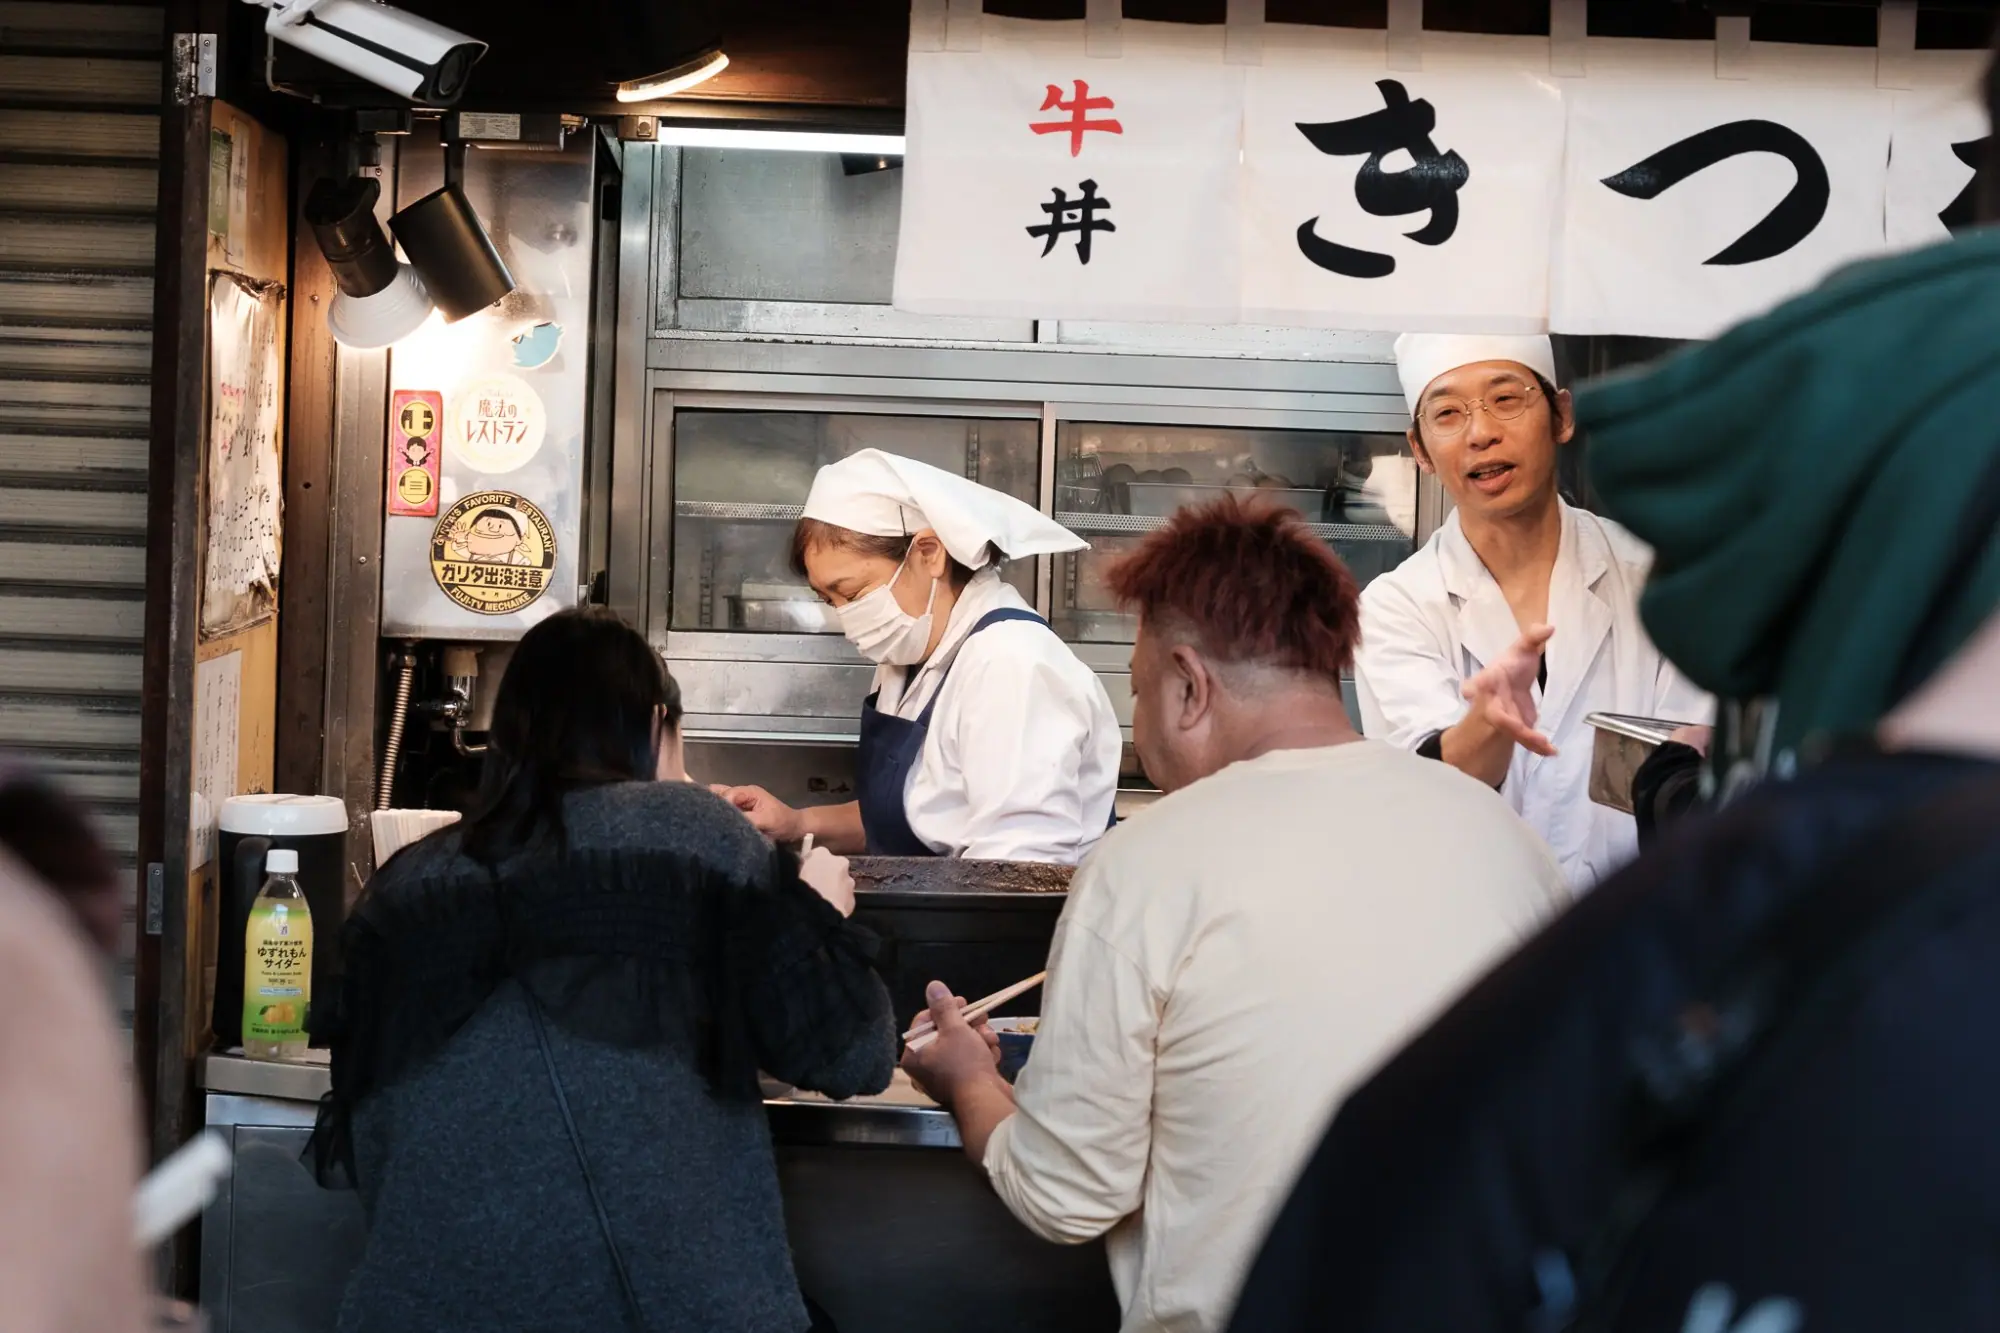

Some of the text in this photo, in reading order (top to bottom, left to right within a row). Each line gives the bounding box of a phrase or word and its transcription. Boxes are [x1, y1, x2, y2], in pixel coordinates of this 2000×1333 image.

[1026, 79, 1123, 265] 牛丼
[1296, 80, 1985, 278] きつ
[479, 398, 518, 418] 魔法の
[467, 420, 528, 445] レストラン
[464, 495, 512, 510] FAVORITE
[516, 500, 553, 553] ESTAURANT
[442, 563, 543, 588] ガリタ出没注意
[451, 587, 531, 612] FUJI-TV MECHAIKE
[257, 946, 307, 958] ゆずれもん
[264, 958, 300, 969] サイダー
